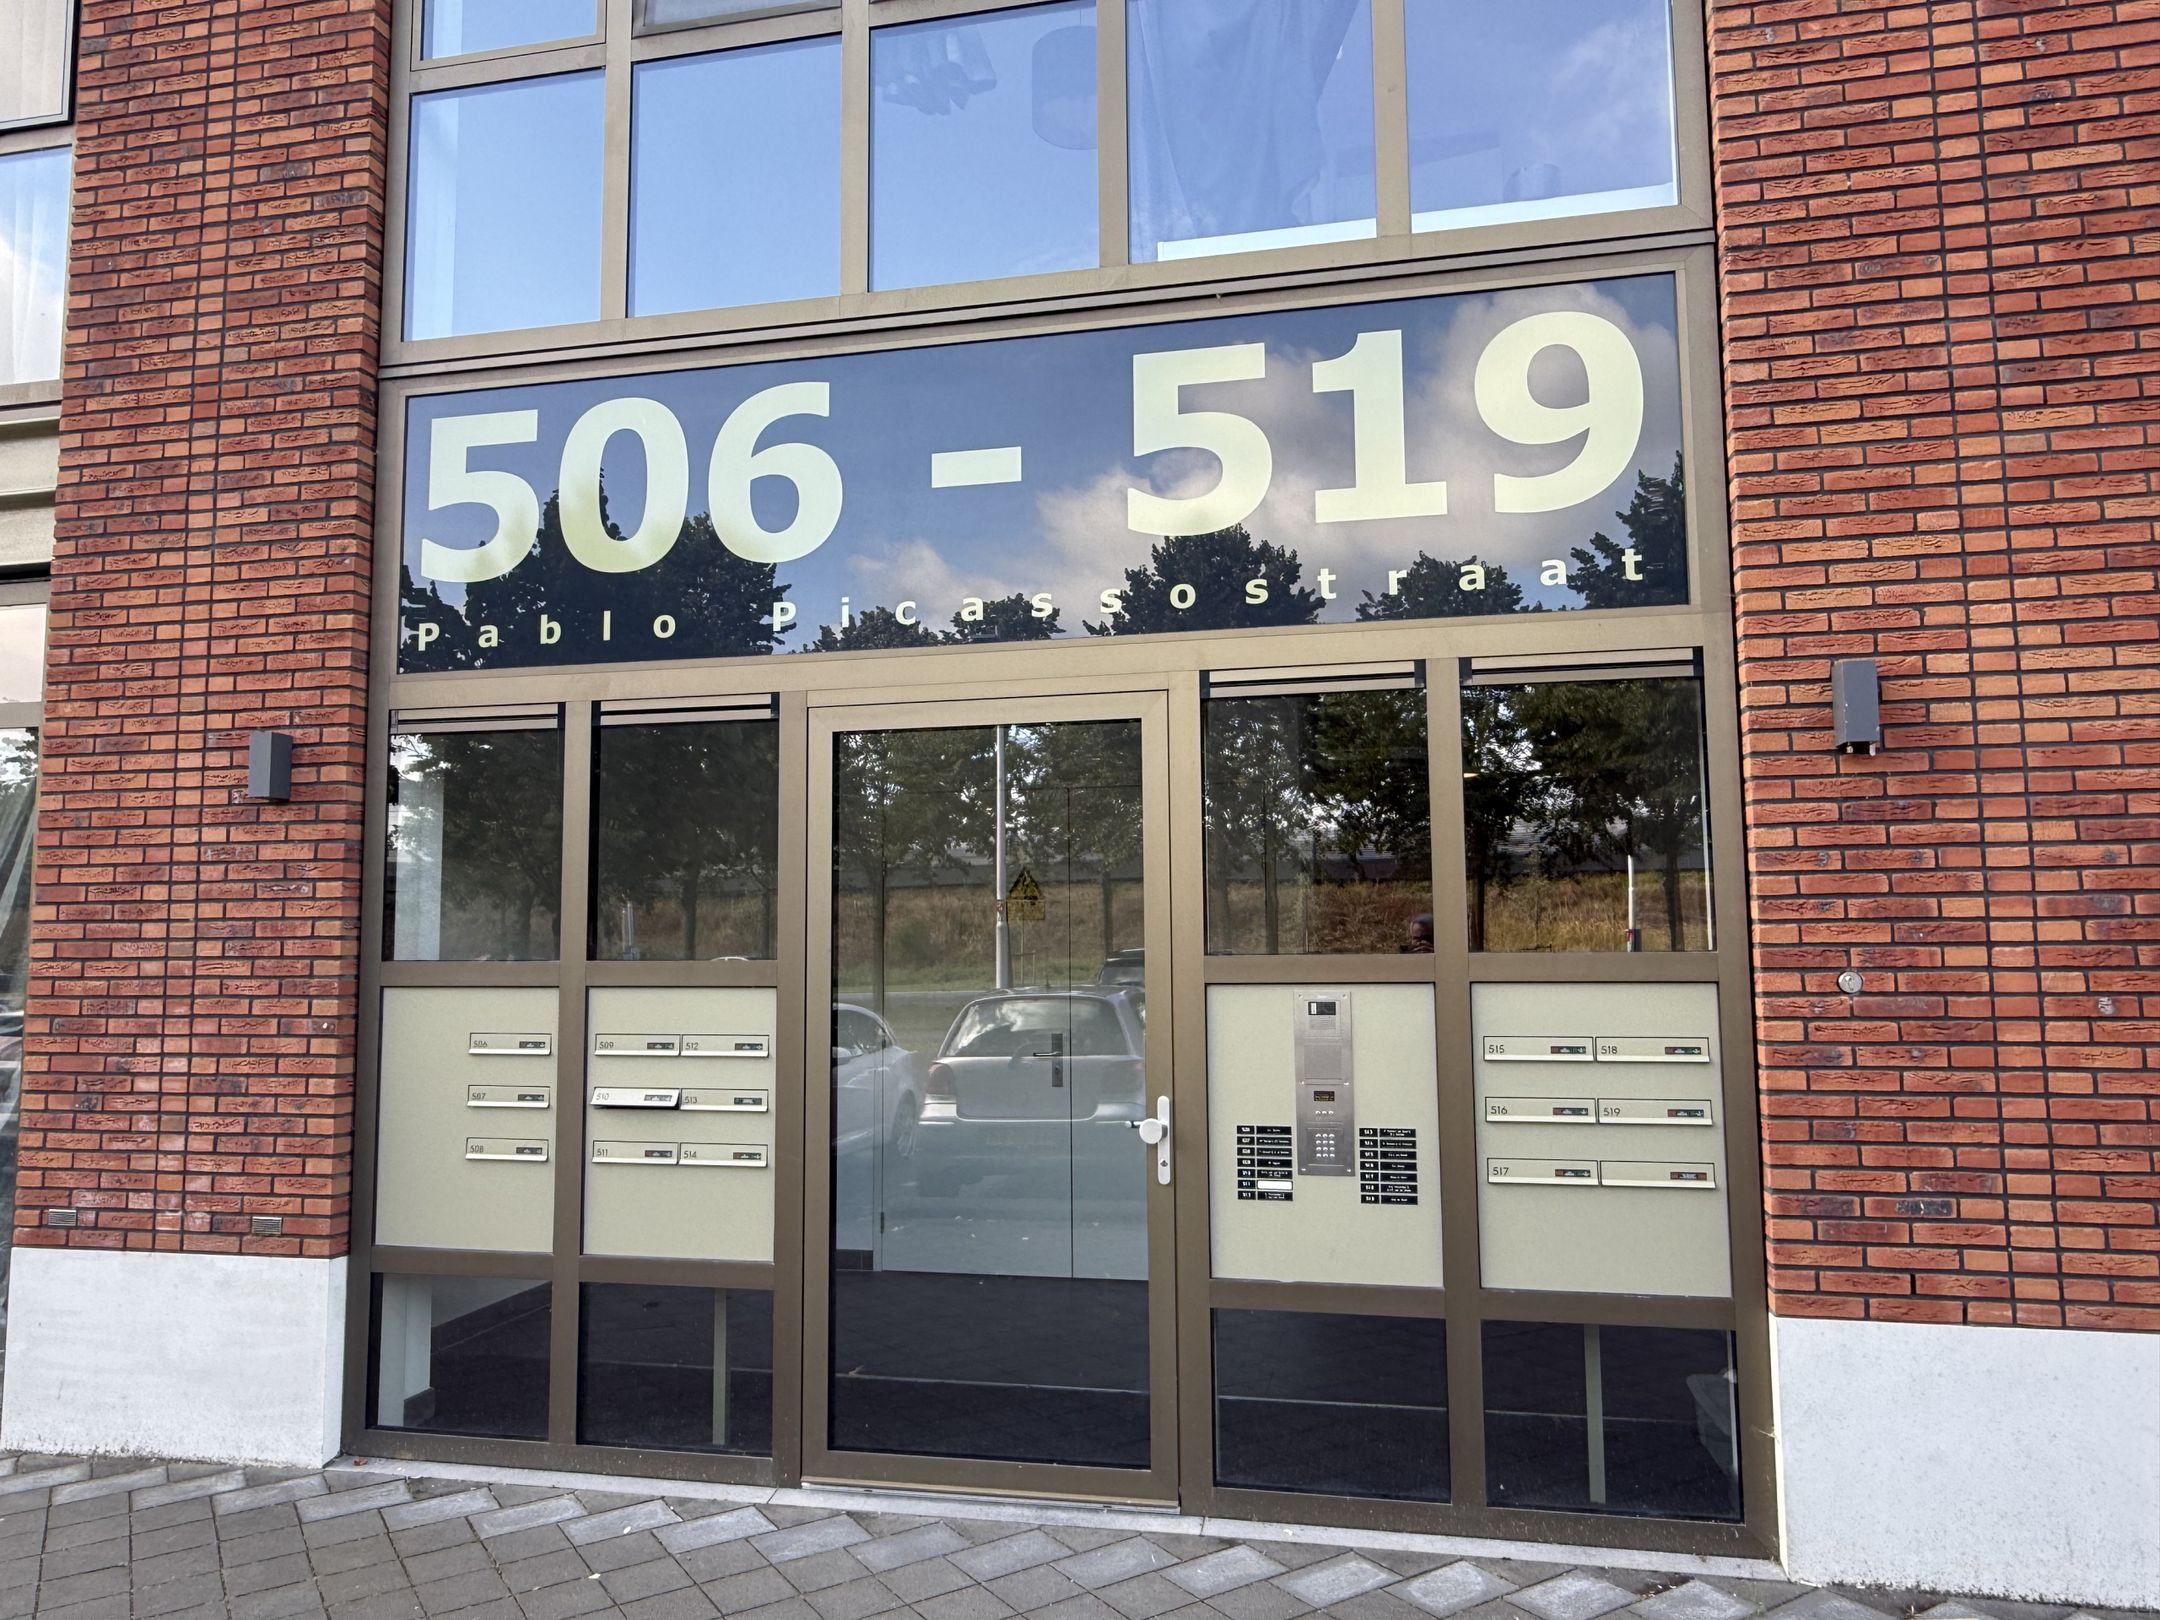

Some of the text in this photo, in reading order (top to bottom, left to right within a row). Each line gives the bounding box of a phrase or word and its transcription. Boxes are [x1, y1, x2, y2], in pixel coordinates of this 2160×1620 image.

[420, 311, 1646, 583] 506 - 519
[417, 547, 1644, 652] Pablo Picassostraat
[599, 1041, 614, 1049] 509
[685, 1042, 698, 1050] 512
[1488, 1045, 1505, 1054] 515
[1601, 1045, 1618, 1054] 518
[596, 1093, 609, 1101] 510
[684, 1096, 698, 1104] 513
[1490, 1106, 1508, 1115] 516
[1603, 1107, 1621, 1116] 519
[597, 1148, 608, 1156] 511
[684, 1150, 697, 1158] 514
[1492, 1167, 1509, 1175] 517
